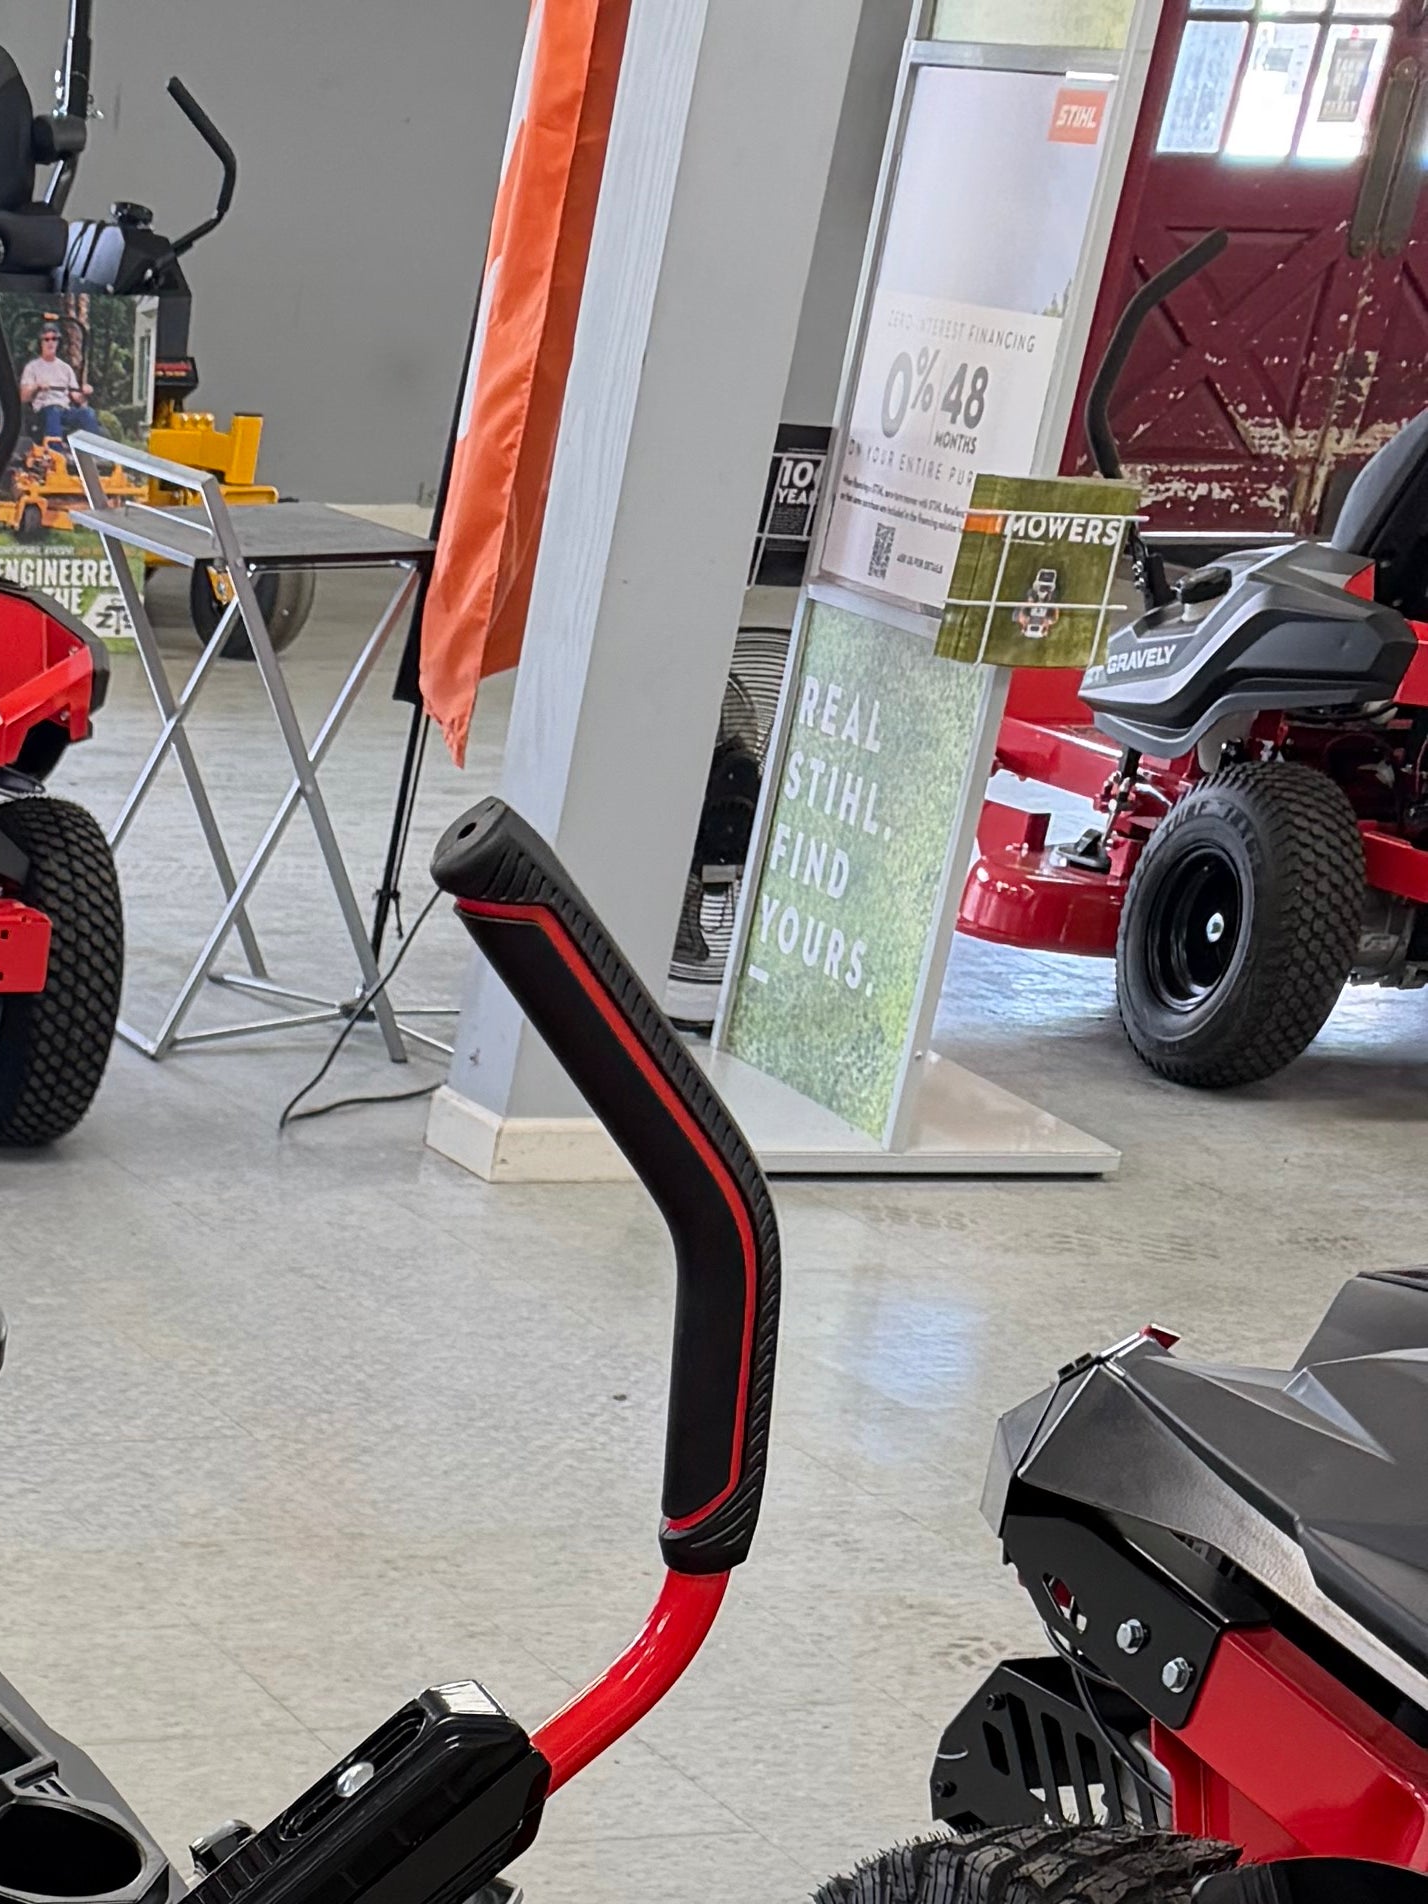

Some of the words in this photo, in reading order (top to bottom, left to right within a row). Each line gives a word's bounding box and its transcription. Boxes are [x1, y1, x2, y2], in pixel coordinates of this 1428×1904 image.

[1056, 105, 1096, 128] STIHL
[968, 324, 1036, 353] FINANCING
[941, 363, 989, 429] 48
[934, 430, 977, 454] MONTHS
[899, 454, 943, 480] ENTIRE
[949, 467, 973, 486] PUR
[1004, 516, 1121, 545] MOWERS
[1107, 645, 1176, 674] GRAVELY
[798, 675, 881, 753] REAL
[784, 750, 892, 841] STIHL.
[770, 825, 850, 900] FIND
[756, 893, 874, 998] YOURS.
